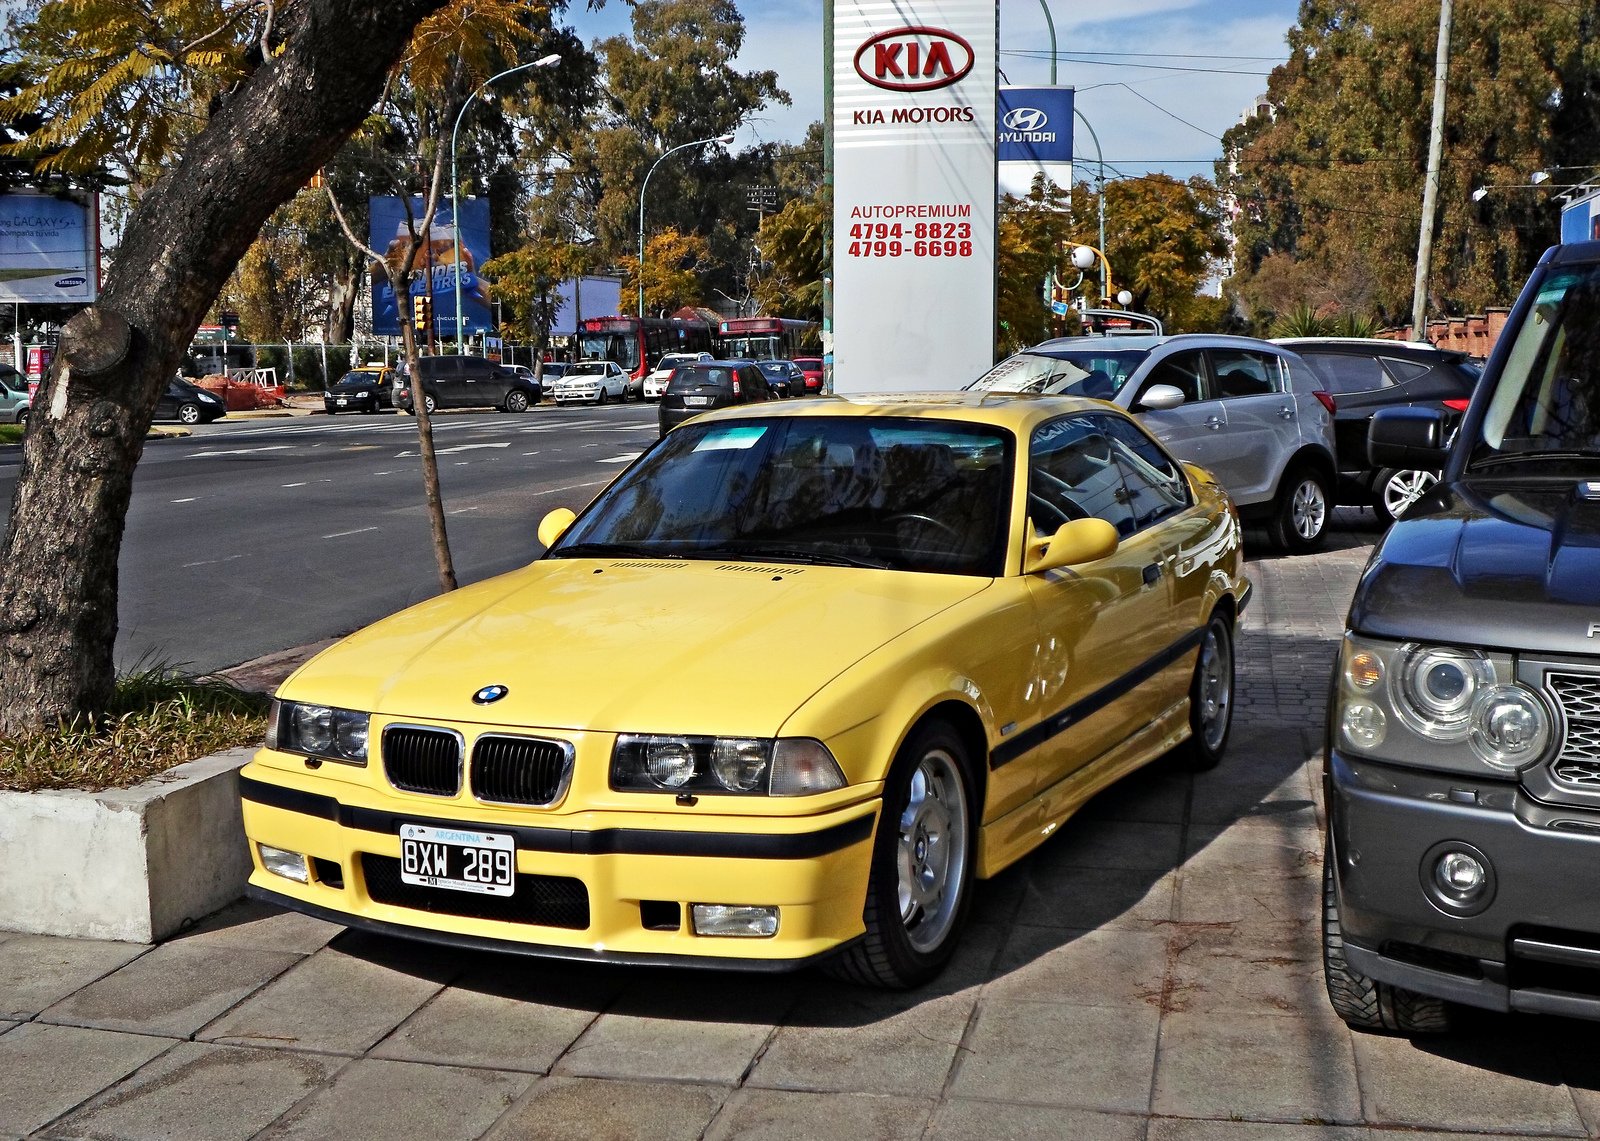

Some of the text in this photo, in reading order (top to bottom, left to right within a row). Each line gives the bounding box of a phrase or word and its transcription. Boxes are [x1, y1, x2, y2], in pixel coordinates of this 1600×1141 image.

[874, 41, 954, 77] KIA
[854, 106, 974, 125] KIA MOTORS
[998, 132, 1056, 143] HYUNDAI
[851, 204, 971, 218] AUTOPREMIUM
[14, 216, 58, 227] GALAXY
[850, 222, 971, 239] 4794-8823
[848, 240, 973, 257] 4799-6698
[435, 831, 481, 843] ARGENTINA
[404, 841, 510, 885] BXW 289
